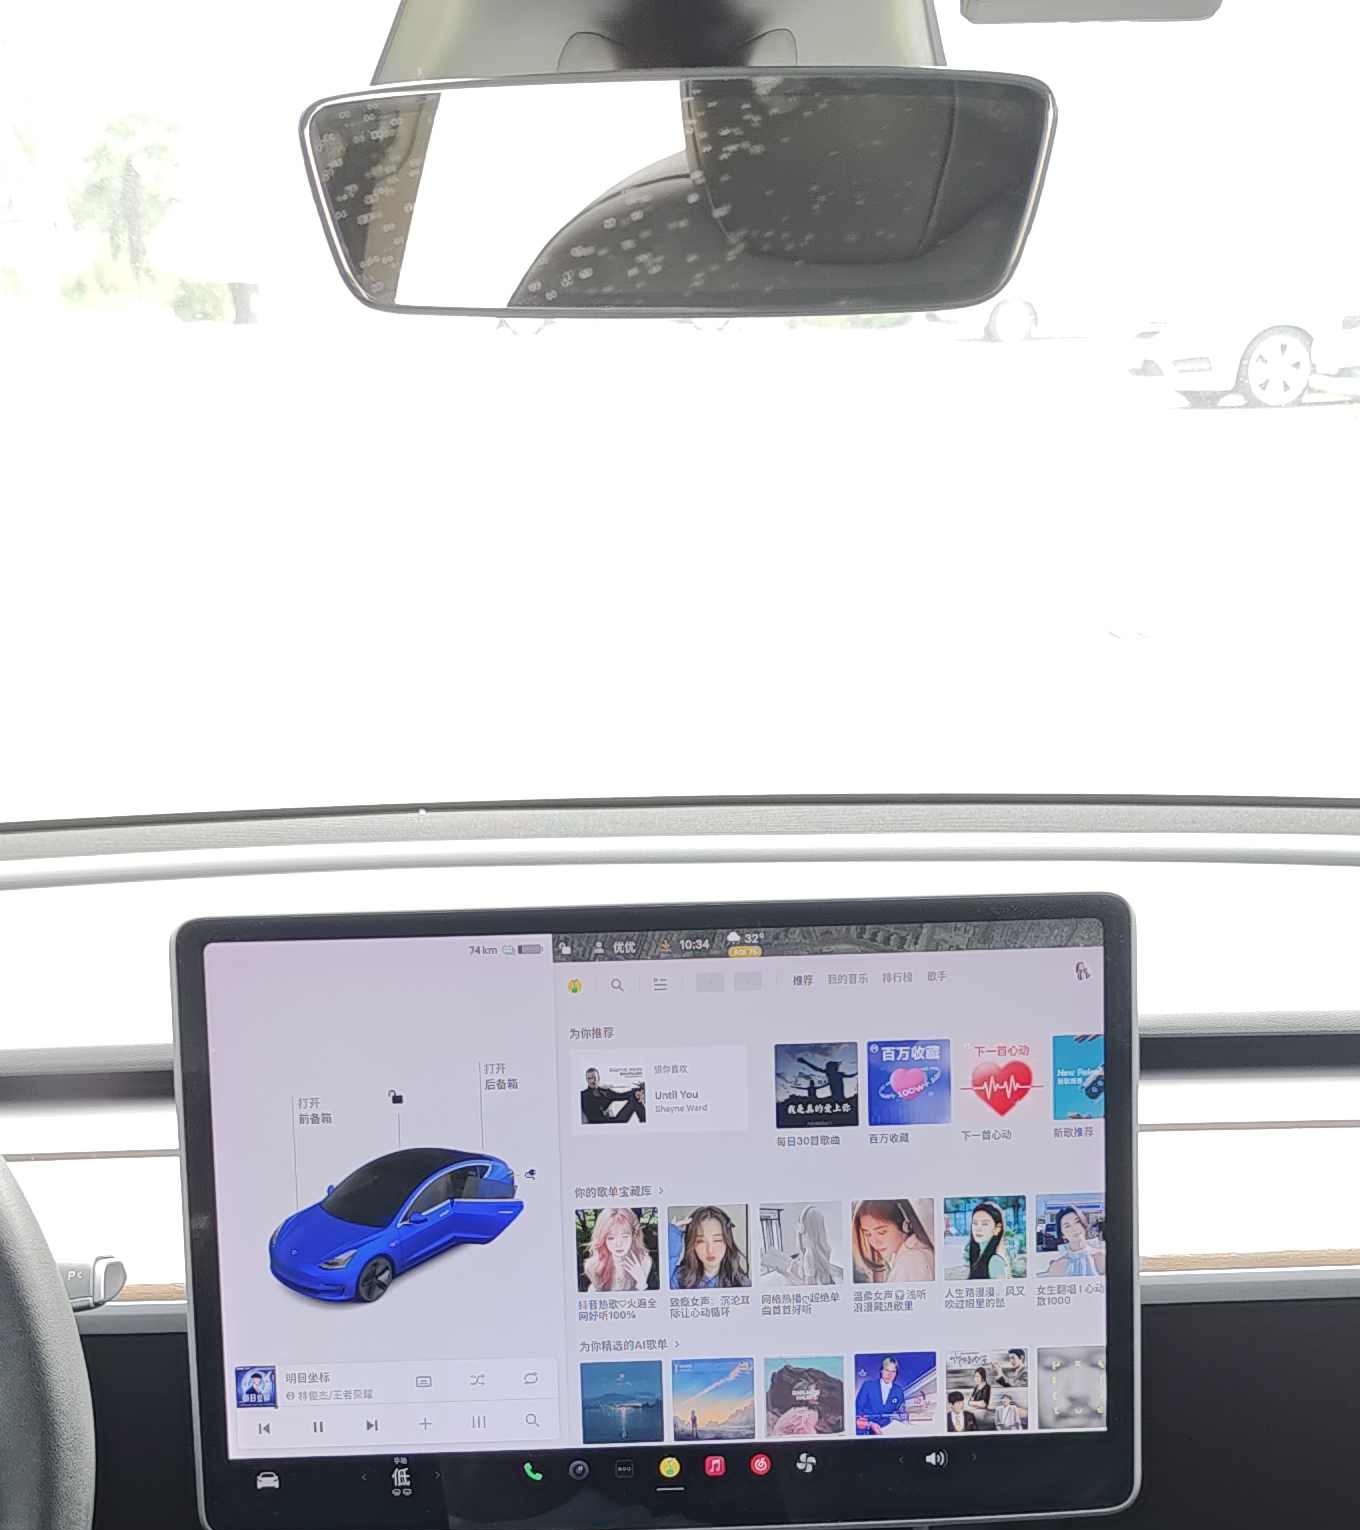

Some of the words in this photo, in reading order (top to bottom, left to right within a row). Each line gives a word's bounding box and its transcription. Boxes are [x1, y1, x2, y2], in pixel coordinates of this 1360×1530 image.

[679, 939, 710, 951] 10:34
[569, 1026, 616, 1041] 为你推荐
[881, 1045, 940, 1061] 百万收藏
[974, 1044, 1030, 1058] 下一首心动
[484, 1063, 506, 1075] 打开
[484, 1078, 519, 1090] 后备箱
[655, 1090, 678, 1100] Until
[681, 1089, 699, 1099] You
[298, 1097, 320, 1109] 打开
[299, 1112, 332, 1125] 前备箱
[869, 1132, 910, 1144] 百万收藏
[961, 1128, 1012, 1141] 下一首心动
[574, 1186, 652, 1199] 你的歌单宝藏库
[579, 1338, 668, 1352] 为你精选的AI歌单
[391, 1467, 411, 1487] 低
